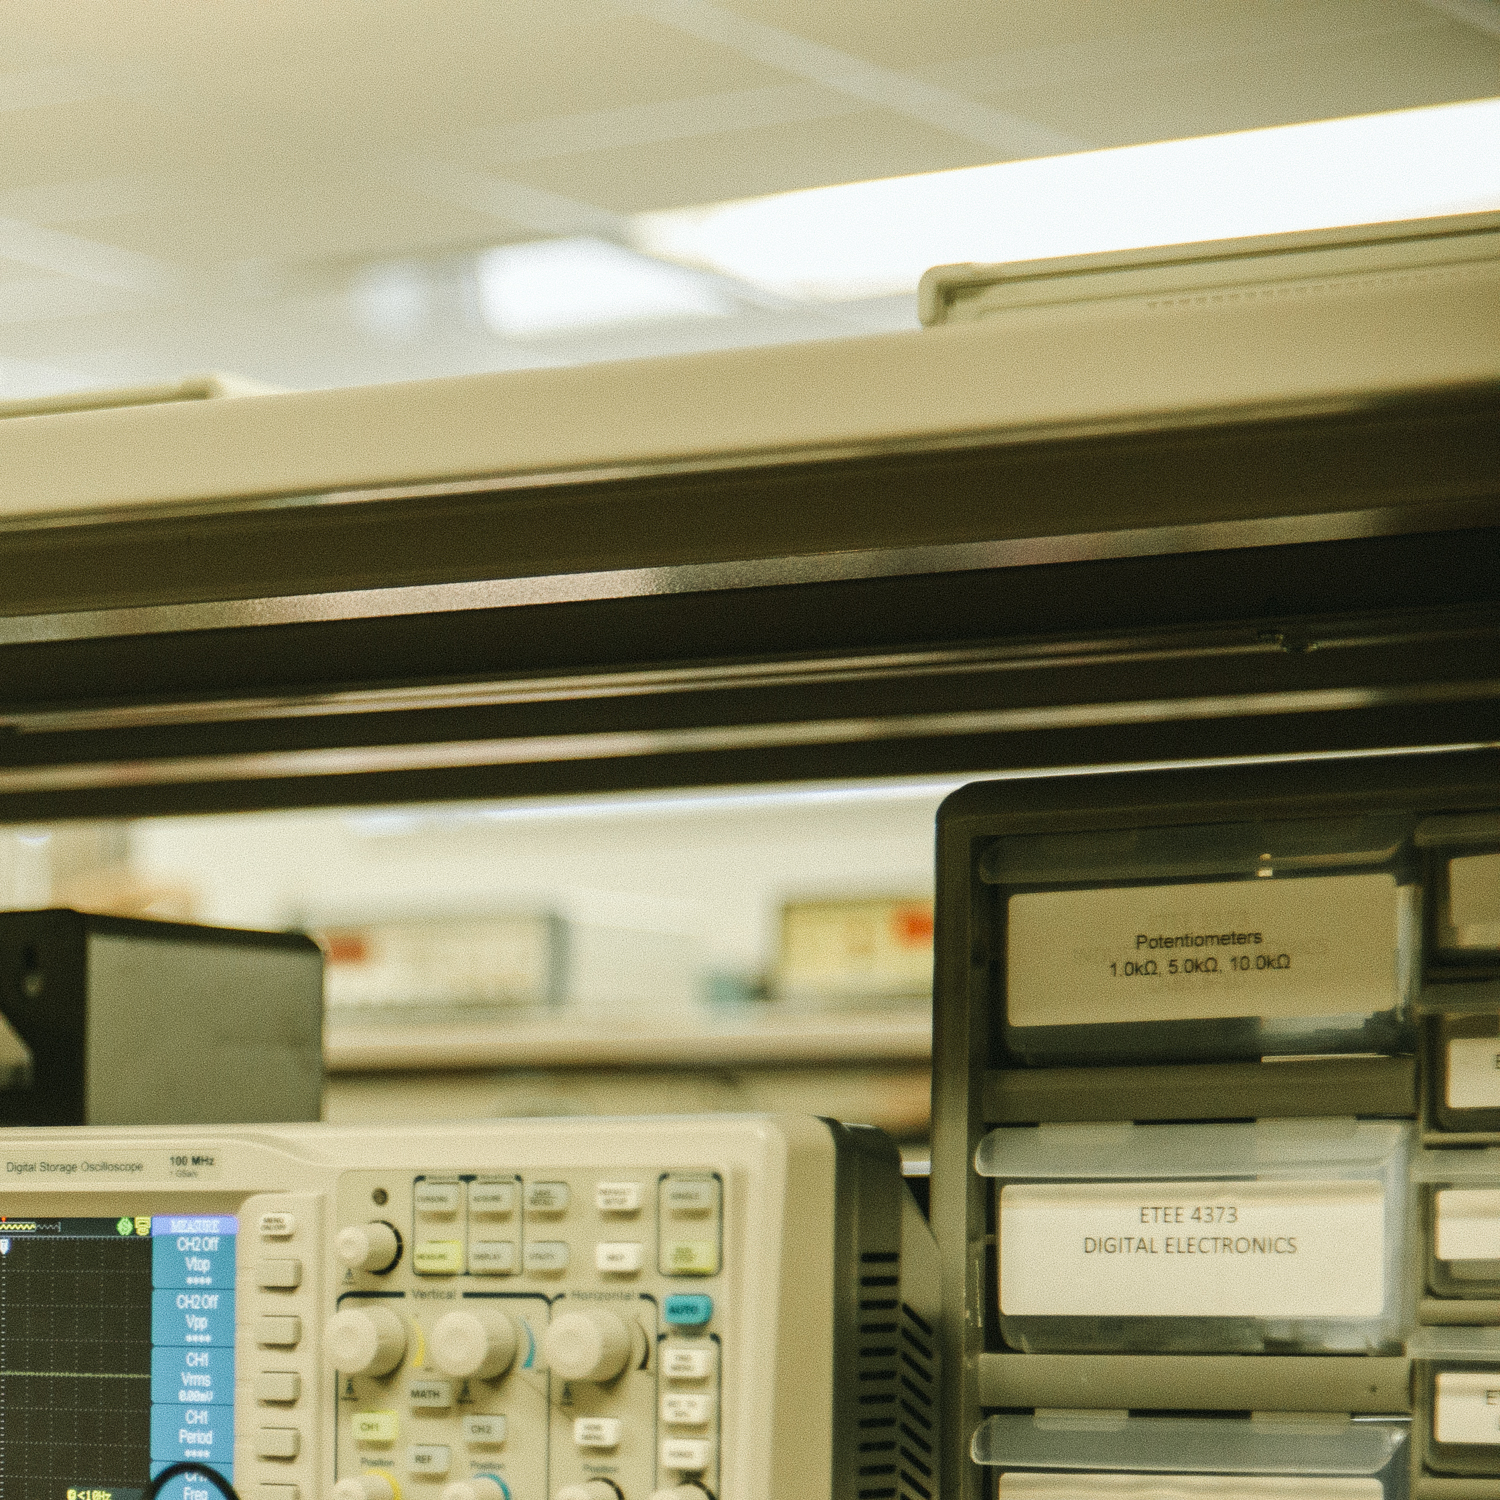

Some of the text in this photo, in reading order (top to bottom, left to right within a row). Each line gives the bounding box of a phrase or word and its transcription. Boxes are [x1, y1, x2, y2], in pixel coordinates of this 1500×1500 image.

[1135, 931, 1263, 950] Potentiometers
[1109, 953, 1292, 977] 1.0kΩ, 5.0kΩ, 10.0kΩ
[5, 1161, 144, 1175] Digital Storage Oscilloscope
[169, 1155, 215, 1167] 100 MHz
[1139, 1205, 1239, 1224] ETEE 4373
[1083, 1236, 1298, 1255] DIGITAL ELECTRONICS
[411, 1288, 456, 1300] Vertical
[185, 1314, 209, 1332] Vpp
[185, 1352, 209, 1367] CH1
[181, 1372, 212, 1388] Vrms
[410, 1389, 441, 1399] MATH
[185, 1409, 209, 1425] CH1
[359, 1422, 380, 1432] CH1
[470, 1425, 492, 1434] CH2
[179, 1428, 213, 1445] Period
[360, 1457, 395, 1468] Position
[414, 1455, 433, 1464] REF
[470, 1460, 505, 1471] Position
